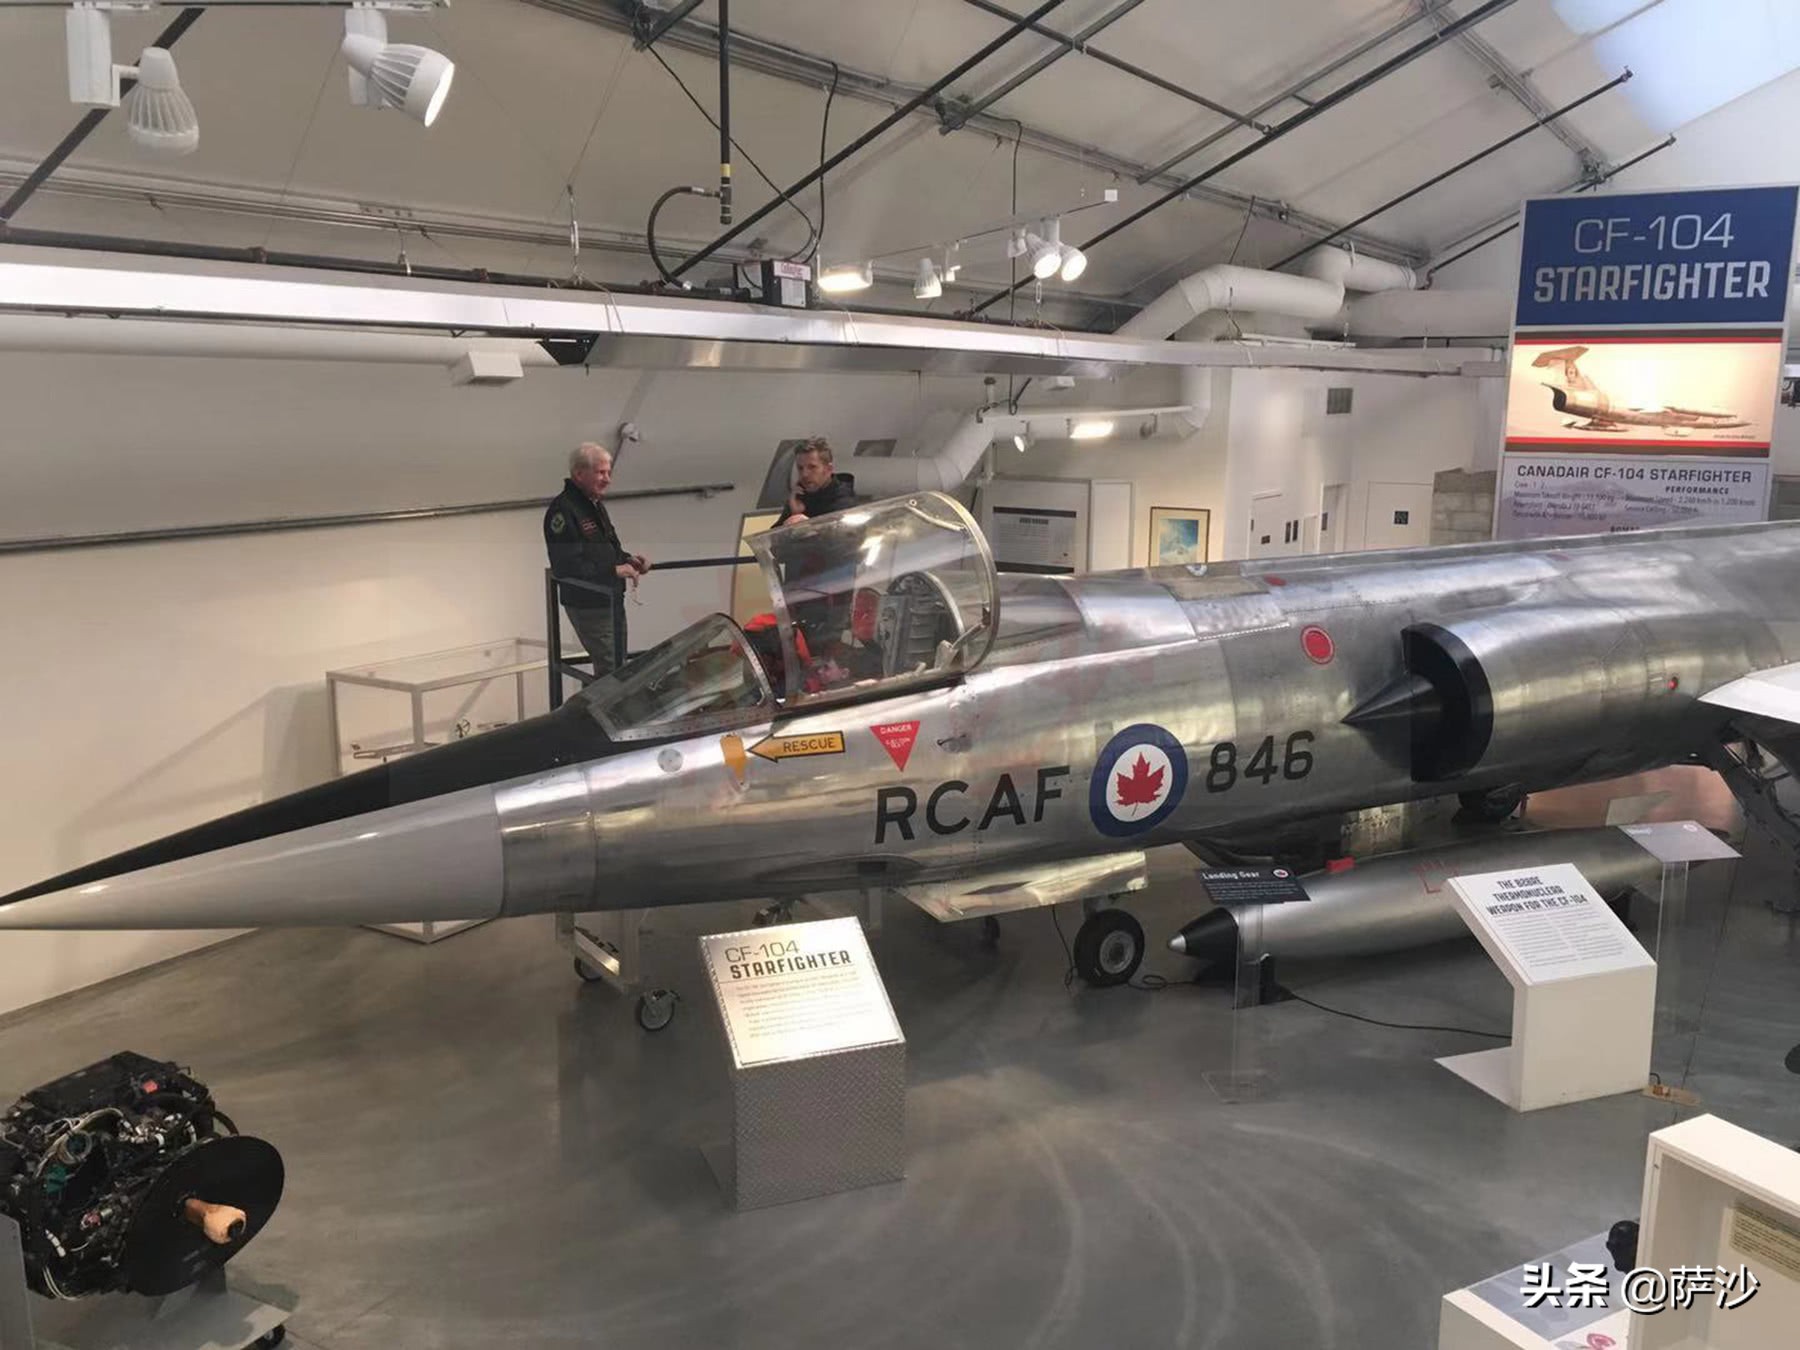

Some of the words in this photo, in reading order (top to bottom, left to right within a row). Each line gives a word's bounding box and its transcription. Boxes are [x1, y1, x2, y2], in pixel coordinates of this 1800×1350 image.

[1574, 213, 1734, 254] CF-104
[1533, 260, 1771, 303] STARFIGHTER
[1517, 465, 1589, 478] CANADAIR
[1594, 466, 1645, 480] CF-104
[1650, 469, 1752, 483] STARFIGHTER
[1665, 486, 1730, 495] PERFORMANCE
[880, 724, 912, 734] DANGER
[783, 737, 836, 753] RESCUE
[874, 765, 1071, 844] RCAF
[1206, 730, 1315, 794] 846
[1202, 871, 1238, 880] Landing
[1496, 878, 1516, 889] THE
[1493, 885, 1566, 902] THERMONUCLEAR
[1486, 902, 1526, 915] WEAPON
[1523, 900, 1542, 911] FOR
[1540, 898, 1560, 909] THE
[1557, 894, 1589, 906] CF-104
[725, 940, 800, 963] CF-104
[730, 950, 852, 979] STARFIGHTER
